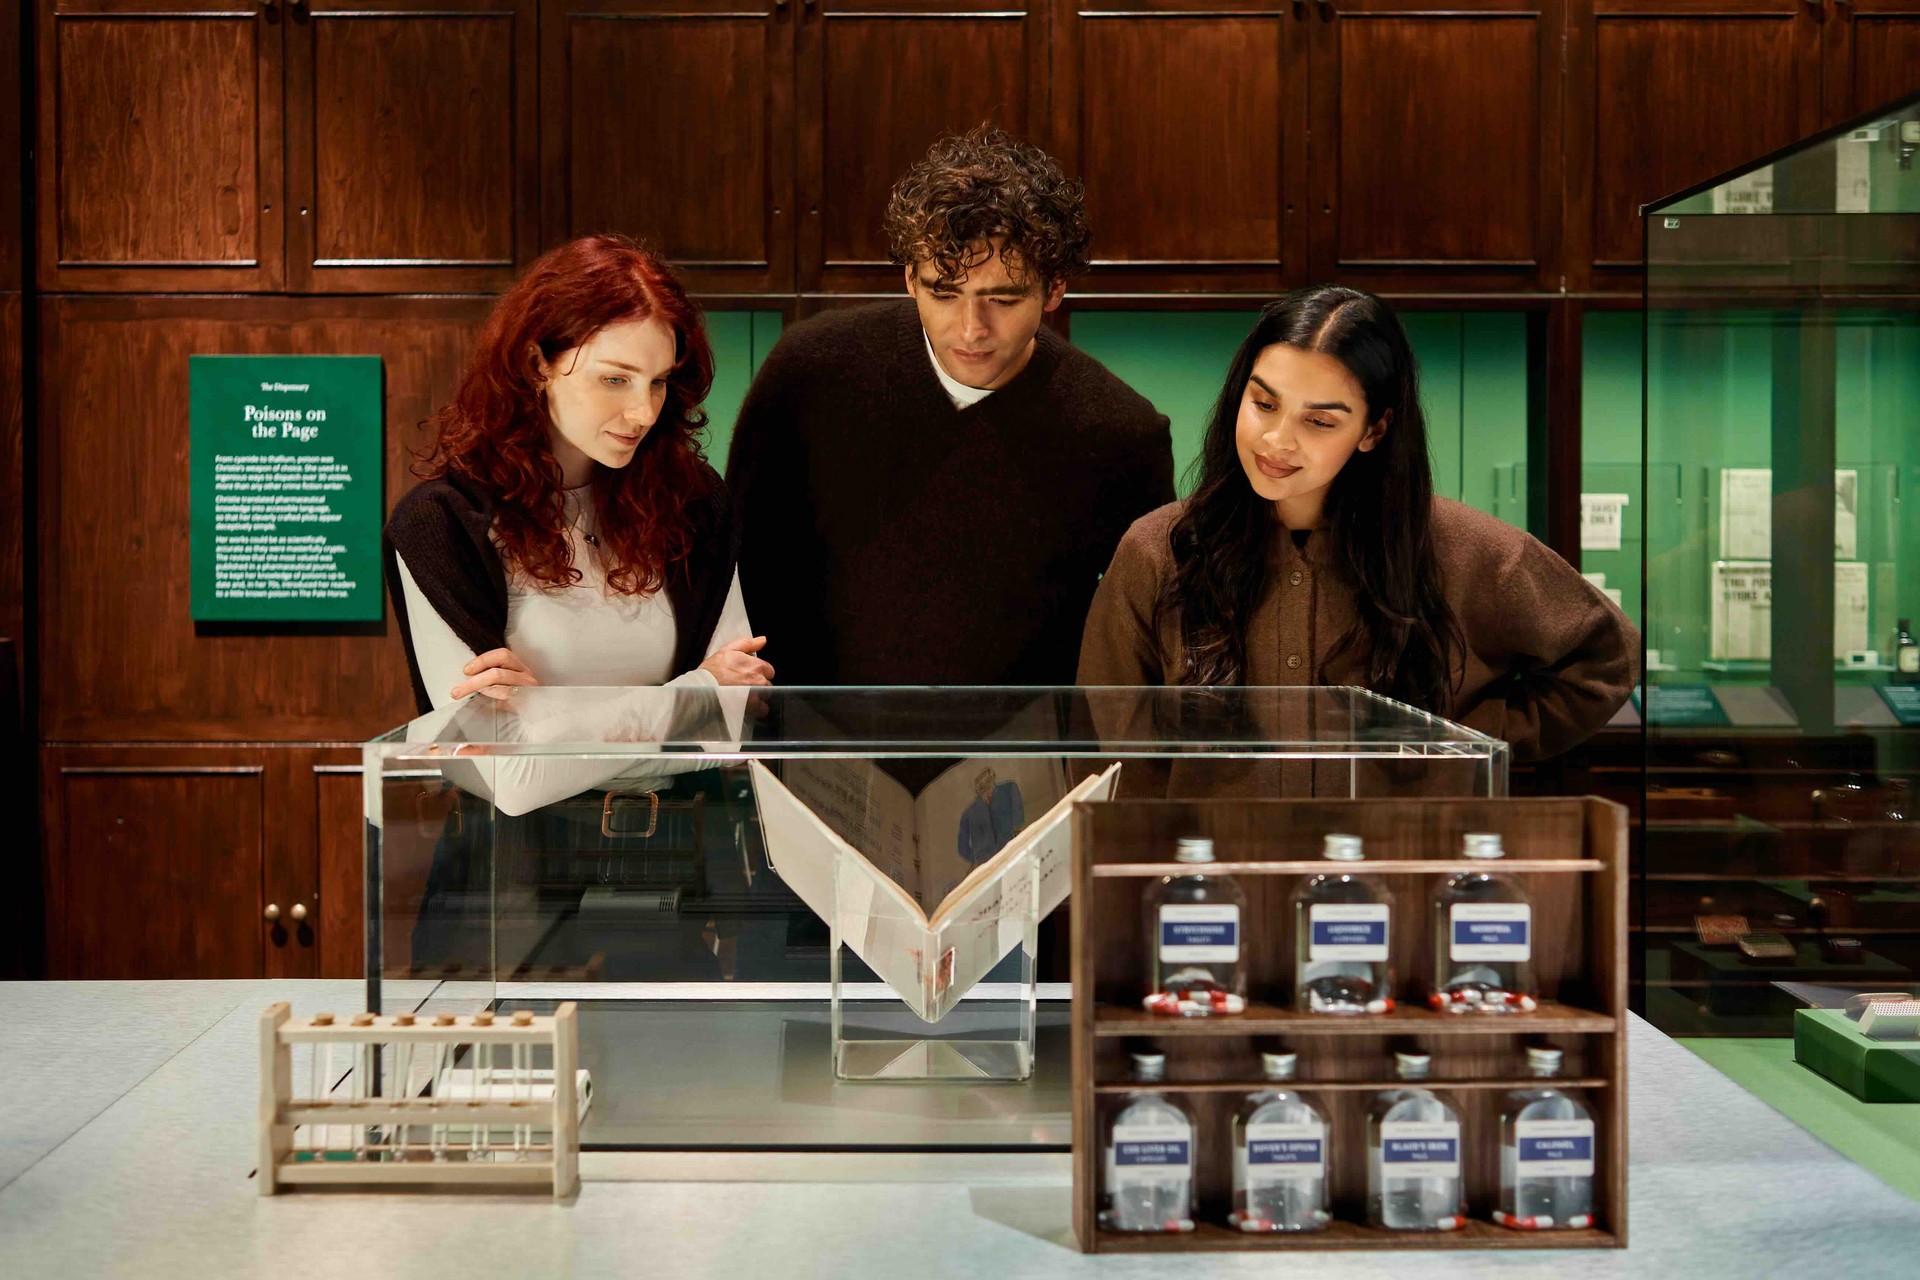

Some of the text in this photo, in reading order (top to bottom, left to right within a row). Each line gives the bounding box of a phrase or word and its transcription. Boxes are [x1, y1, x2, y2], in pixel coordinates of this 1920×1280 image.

[260, 382, 310, 393] The Dispensary
[244, 405, 326, 422] Poisons on
[252, 422, 319, 442] the Page
